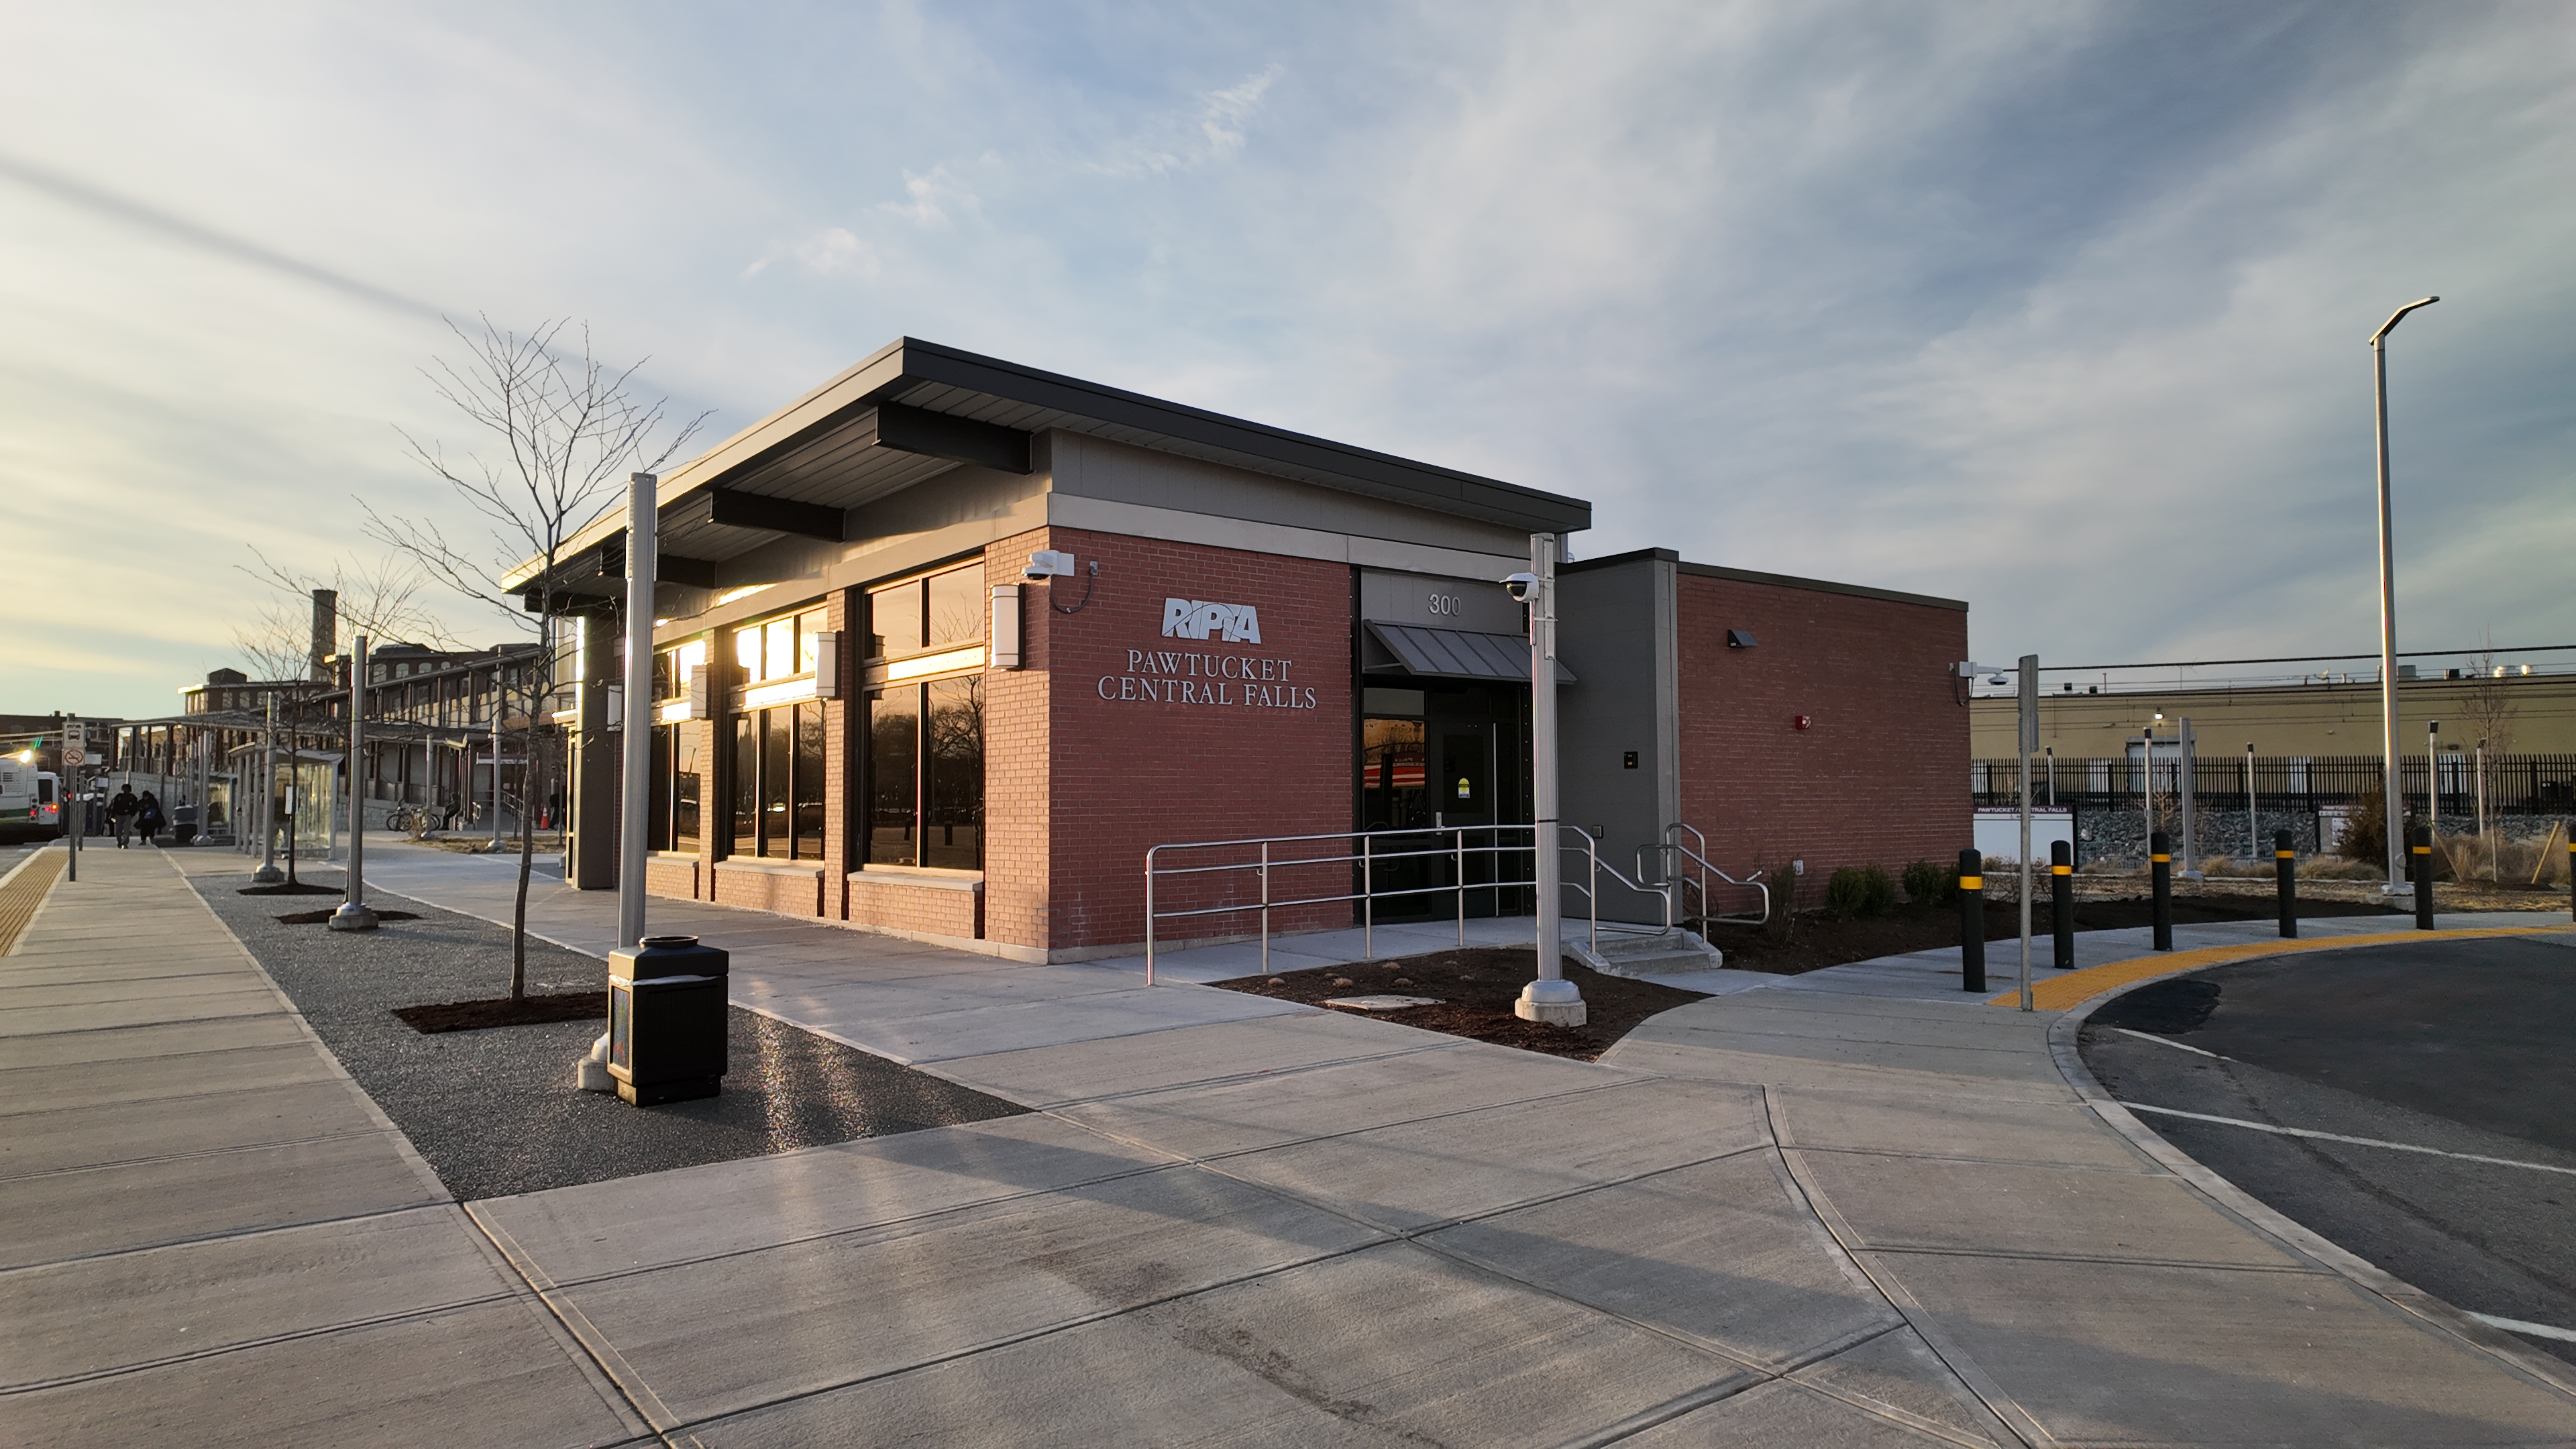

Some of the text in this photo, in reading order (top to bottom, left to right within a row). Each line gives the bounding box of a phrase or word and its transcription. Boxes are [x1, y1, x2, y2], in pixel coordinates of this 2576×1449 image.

[1161, 597, 1262, 645] RIPTA
[1429, 594, 1461, 616] 300
[1126, 649, 1292, 682] PAWTUCKET
[1097, 675, 1317, 710] CENTRAL FALLS
